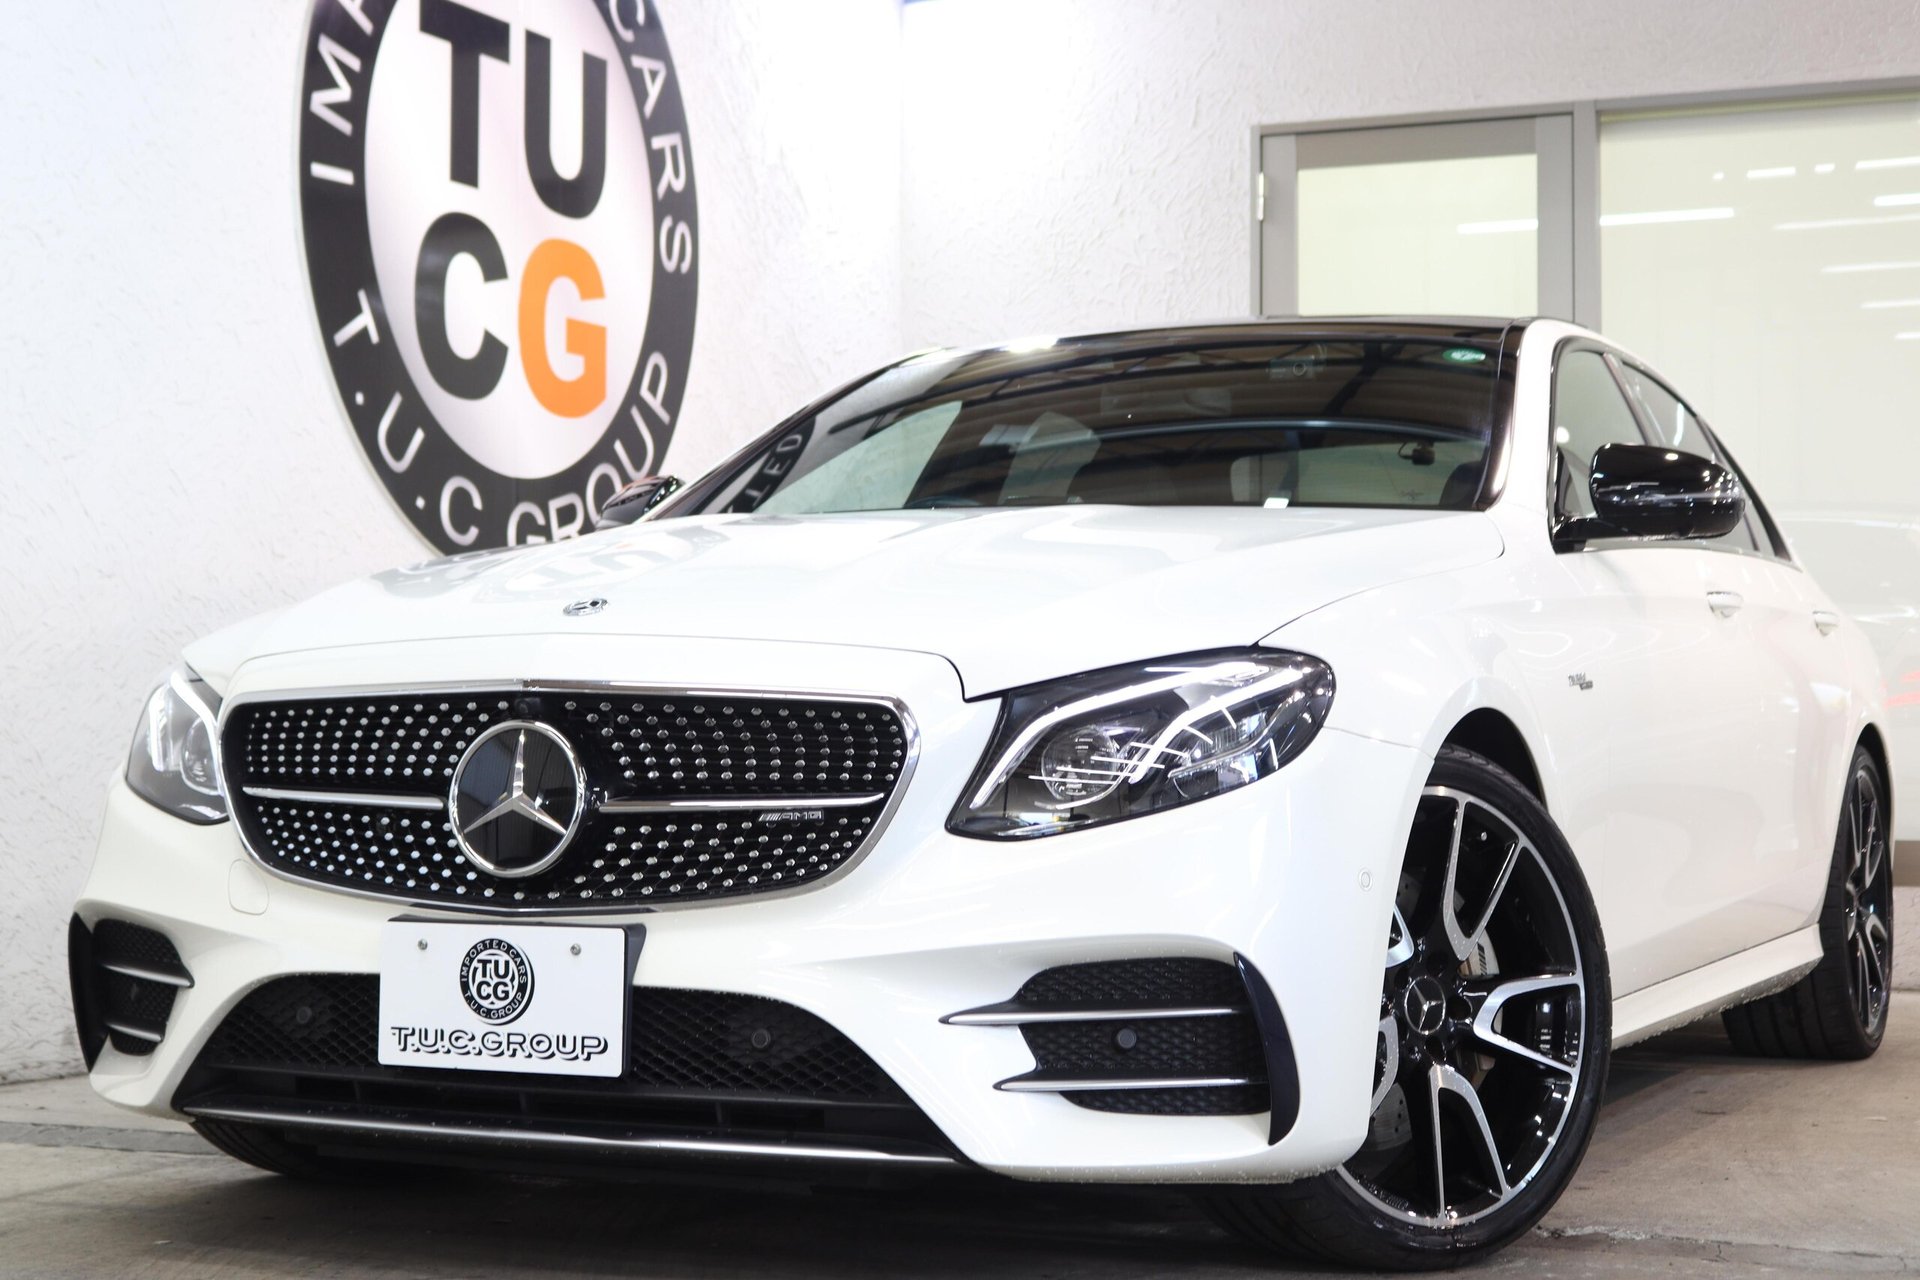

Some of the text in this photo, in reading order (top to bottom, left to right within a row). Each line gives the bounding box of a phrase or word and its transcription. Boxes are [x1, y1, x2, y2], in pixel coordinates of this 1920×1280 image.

[419, 0, 608, 219] TU
[415, 212, 607, 418] CG
[461, 940, 527, 984] IMPORTED CARS
[477, 959, 510, 979] TU
[476, 980, 510, 1001] CG
